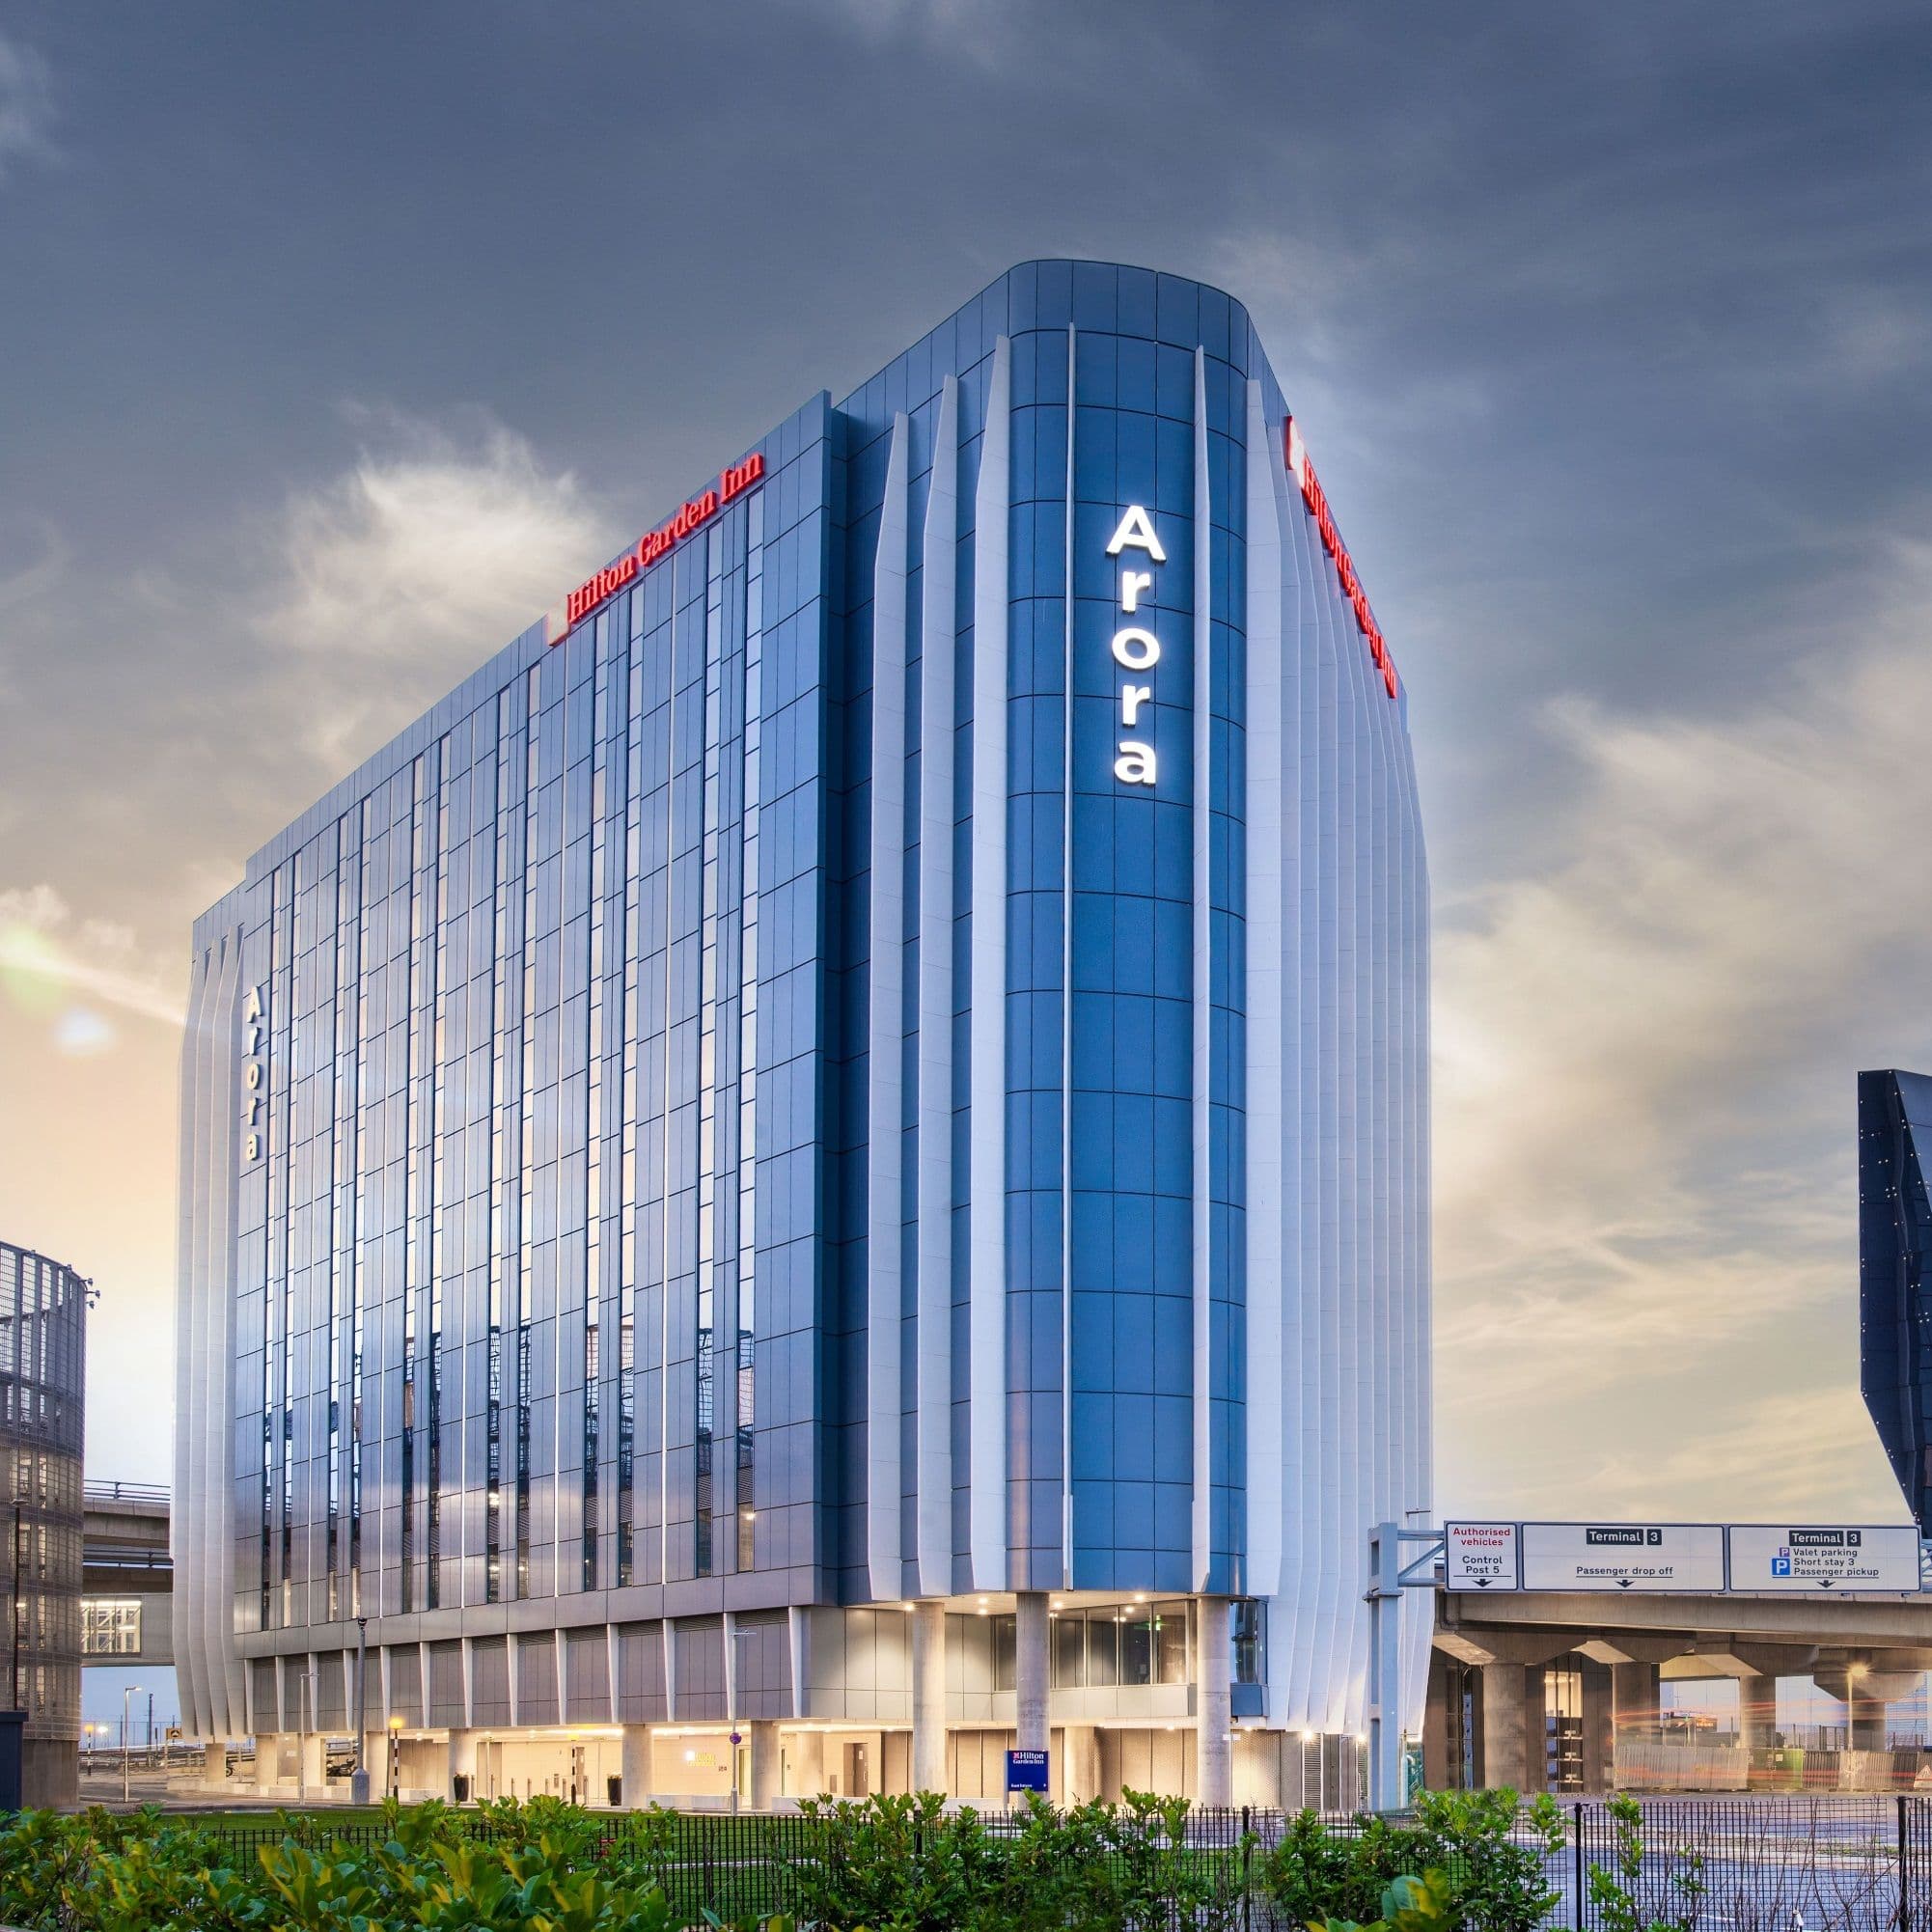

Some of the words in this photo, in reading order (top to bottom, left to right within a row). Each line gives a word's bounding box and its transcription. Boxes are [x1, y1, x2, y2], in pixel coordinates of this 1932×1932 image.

[568, 553, 637, 624] Hilton
[638, 489, 717, 566] Garden
[719, 452, 765, 505] Inn
[1105, 505, 1167, 787] Arora
[246, 985, 264, 1161] Arora
[1452, 1528, 1510, 1536] Authorised
[1589, 1531, 1642, 1542] Terminal
[1650, 1532, 1659, 1542] 3
[1460, 1537, 1504, 1546] vehicles
[1792, 1532, 1841, 1543] Terminal
[1850, 1533, 1858, 1543] 3
[1793, 1548, 1818, 1557] Valet
[1821, 1548, 1858, 1558] parking
[1462, 1556, 1503, 1564] Control
[1794, 1558, 1822, 1566] Short
[1825, 1558, 1845, 1567] stay
[1848, 1558, 1855, 1566] 3
[1466, 1565, 1489, 1574] Post
[1493, 1565, 1500, 1574] 5
[1576, 1566, 1629, 1576] Passenger
[1632, 1566, 1656, 1576] drop
[1658, 1566, 1673, 1575] off
[1794, 1567, 1843, 1576] Passenger
[1847, 1567, 1879, 1577] pickup
